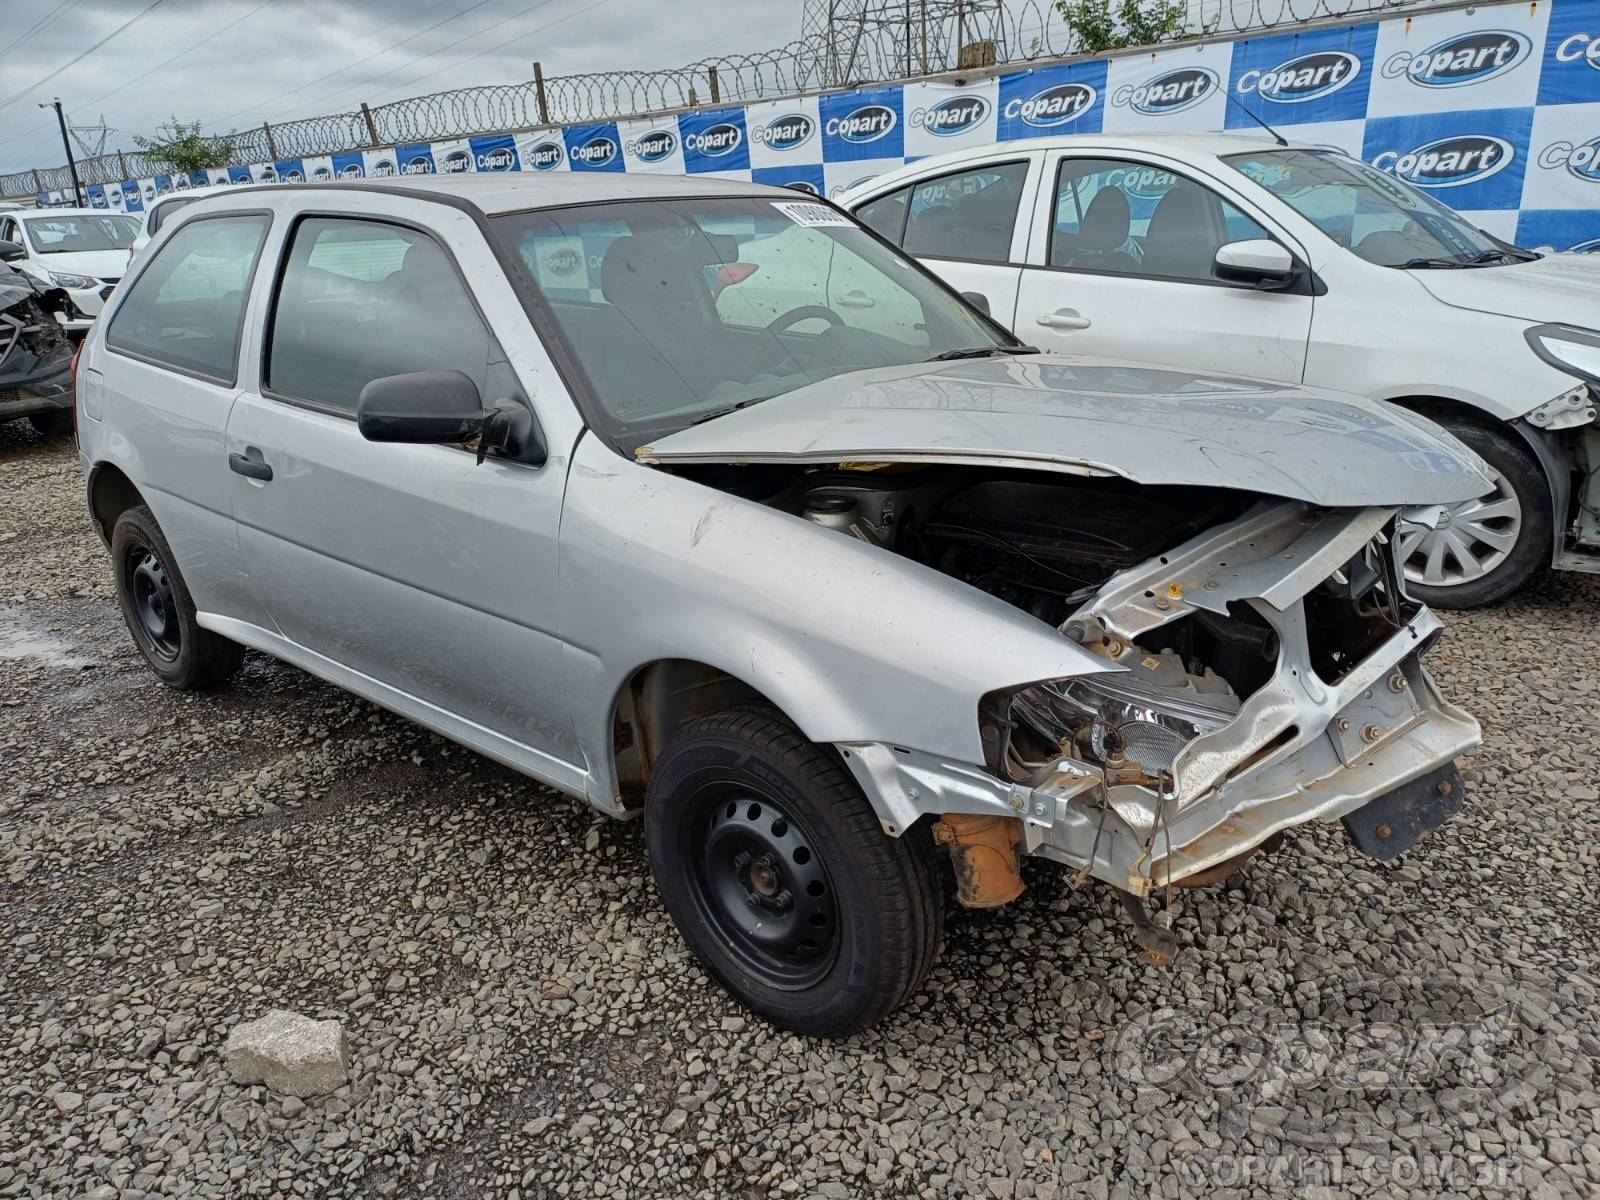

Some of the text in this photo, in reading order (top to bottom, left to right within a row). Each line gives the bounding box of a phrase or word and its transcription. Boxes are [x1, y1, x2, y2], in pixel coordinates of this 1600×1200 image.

[1381, 38, 1513, 79] Copart
[1236, 56, 1347, 95] Copart
[1004, 89, 1086, 119] Copart
[1111, 76, 1206, 109] Copart
[826, 112, 889, 138] Copart
[909, 103, 981, 128] Copart
[685, 130, 735, 150] Copart
[752, 119, 807, 143] Copart
[521, 148, 559, 166] Copart
[571, 142, 612, 161] Copart
[626, 136, 671, 156] Copart
[401, 161, 428, 175] Copart
[438, 157, 470, 173] Copart
[477, 154, 511, 170] Copart
[1371, 144, 1496, 178] Copart
[1105, 168, 1177, 191] Copa
